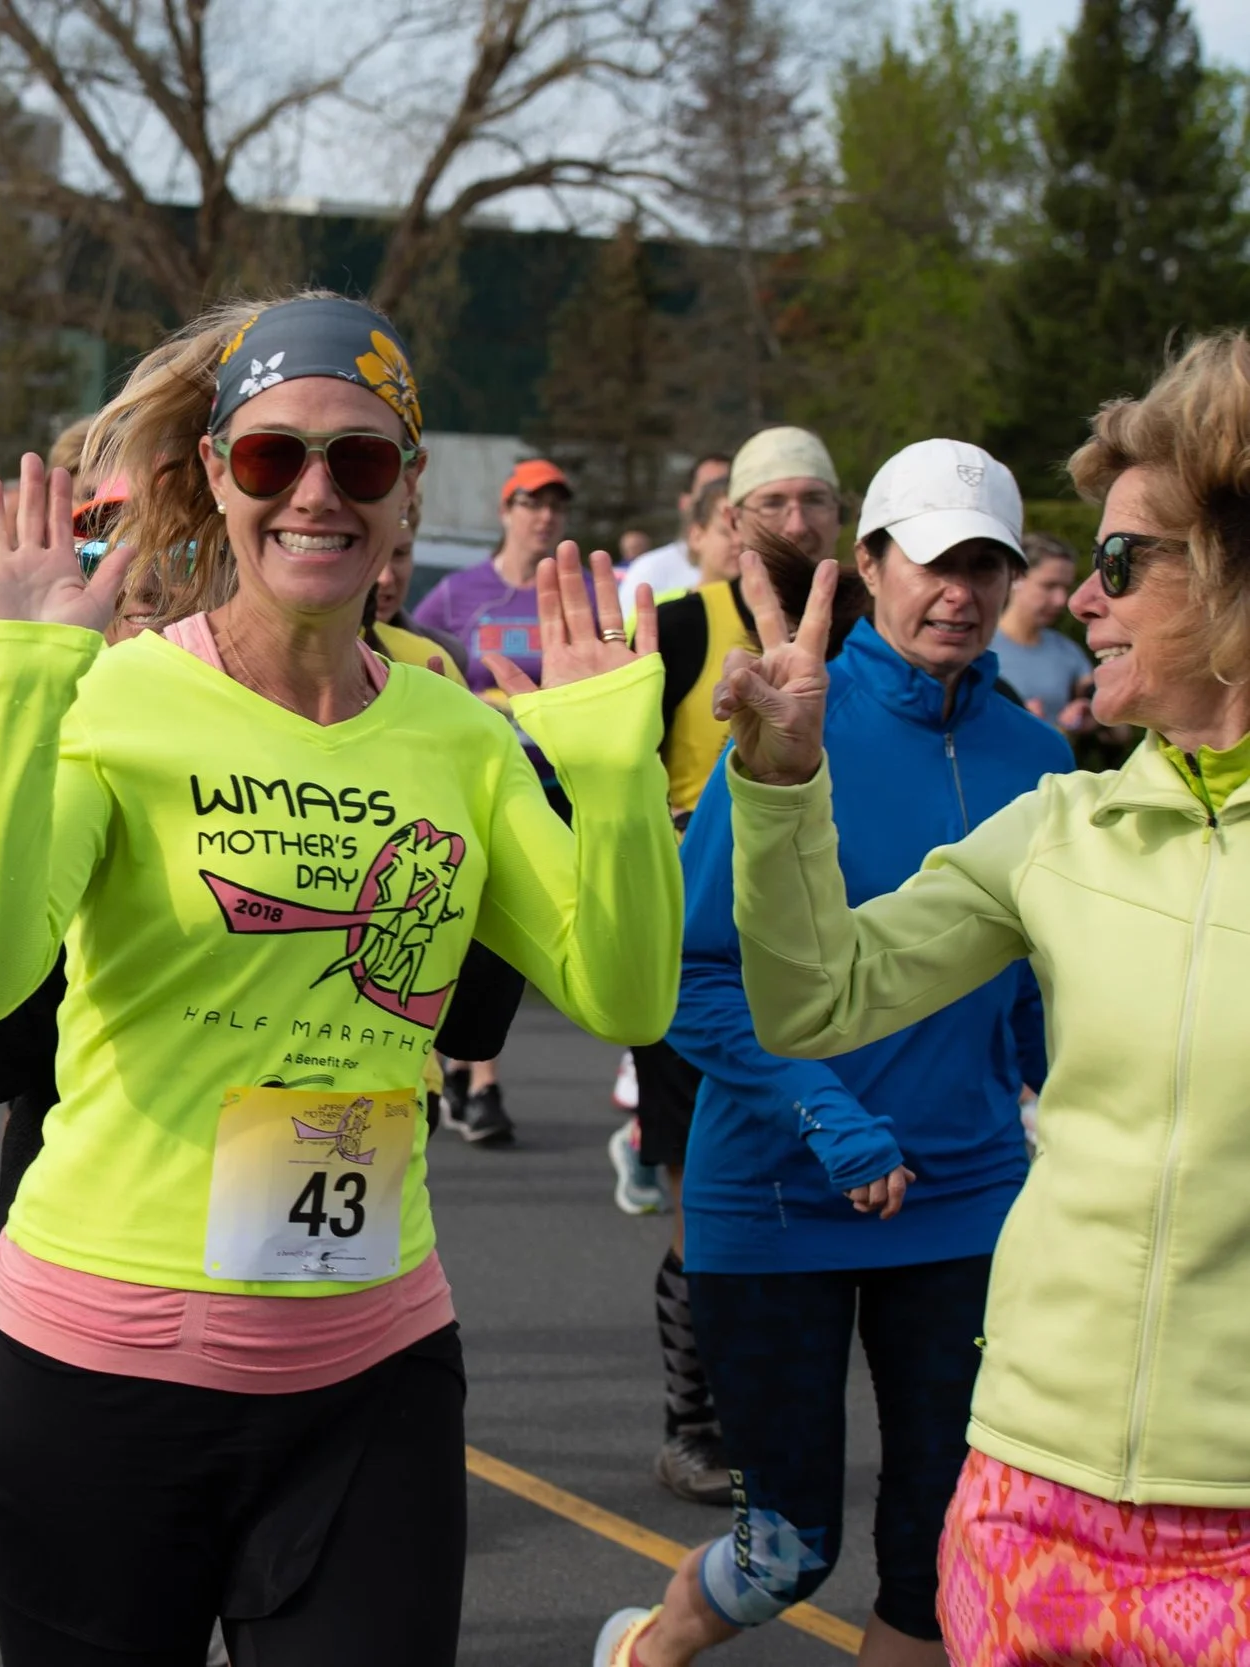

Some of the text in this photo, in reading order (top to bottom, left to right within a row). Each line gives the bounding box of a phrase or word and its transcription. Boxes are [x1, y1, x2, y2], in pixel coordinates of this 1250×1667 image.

[190, 774, 396, 826] WMASS
[198, 829, 358, 860] MOTHER'S
[297, 864, 359, 892] DAY
[234, 898, 283, 922] 2018
[183, 1006, 268, 1032] HALF
[283, 1053, 359, 1069] A Benefit For
[288, 1171, 367, 1238] 43
